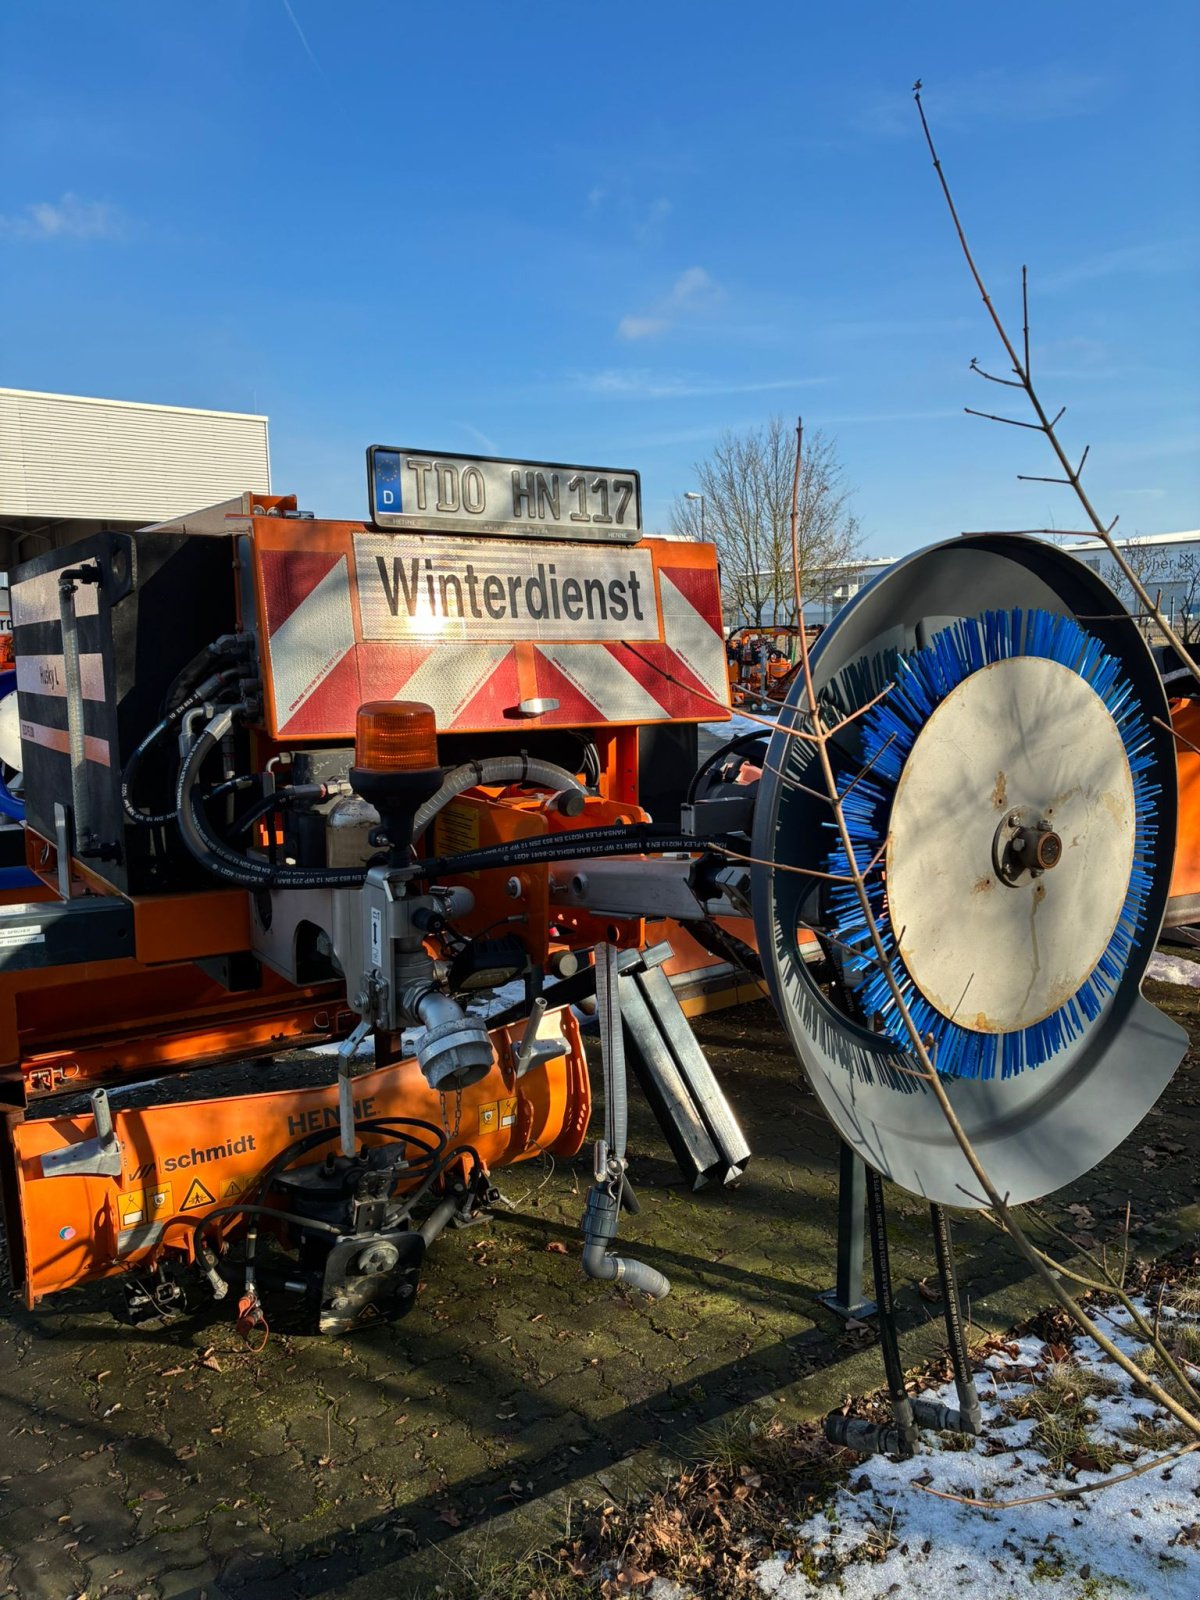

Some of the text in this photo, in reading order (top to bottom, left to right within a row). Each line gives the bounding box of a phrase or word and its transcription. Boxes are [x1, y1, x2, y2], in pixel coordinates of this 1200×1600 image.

[383, 490, 394, 504] D
[407, 460, 633, 524] TDO HN 117
[375, 556, 644, 620] Winterdienst
[563, 832, 584, 842] HD213
[584, 826, 627, 840] HANSA-FLEX
[575, 845, 591, 854] BAR
[591, 844, 603, 852] 275
[604, 843, 615, 851] WP
[650, 840, 660, 848] EN
[315, 876, 323, 884] 12
[164, 1134, 256, 1172] schmidt
[945, 1268, 953, 1280] WP
[946, 1280, 953, 1288] 12
[881, 1271, 891, 1314] HANSA-FLEX
[951, 1314, 959, 1325] EN
[952, 1324, 962, 1345] HD213
